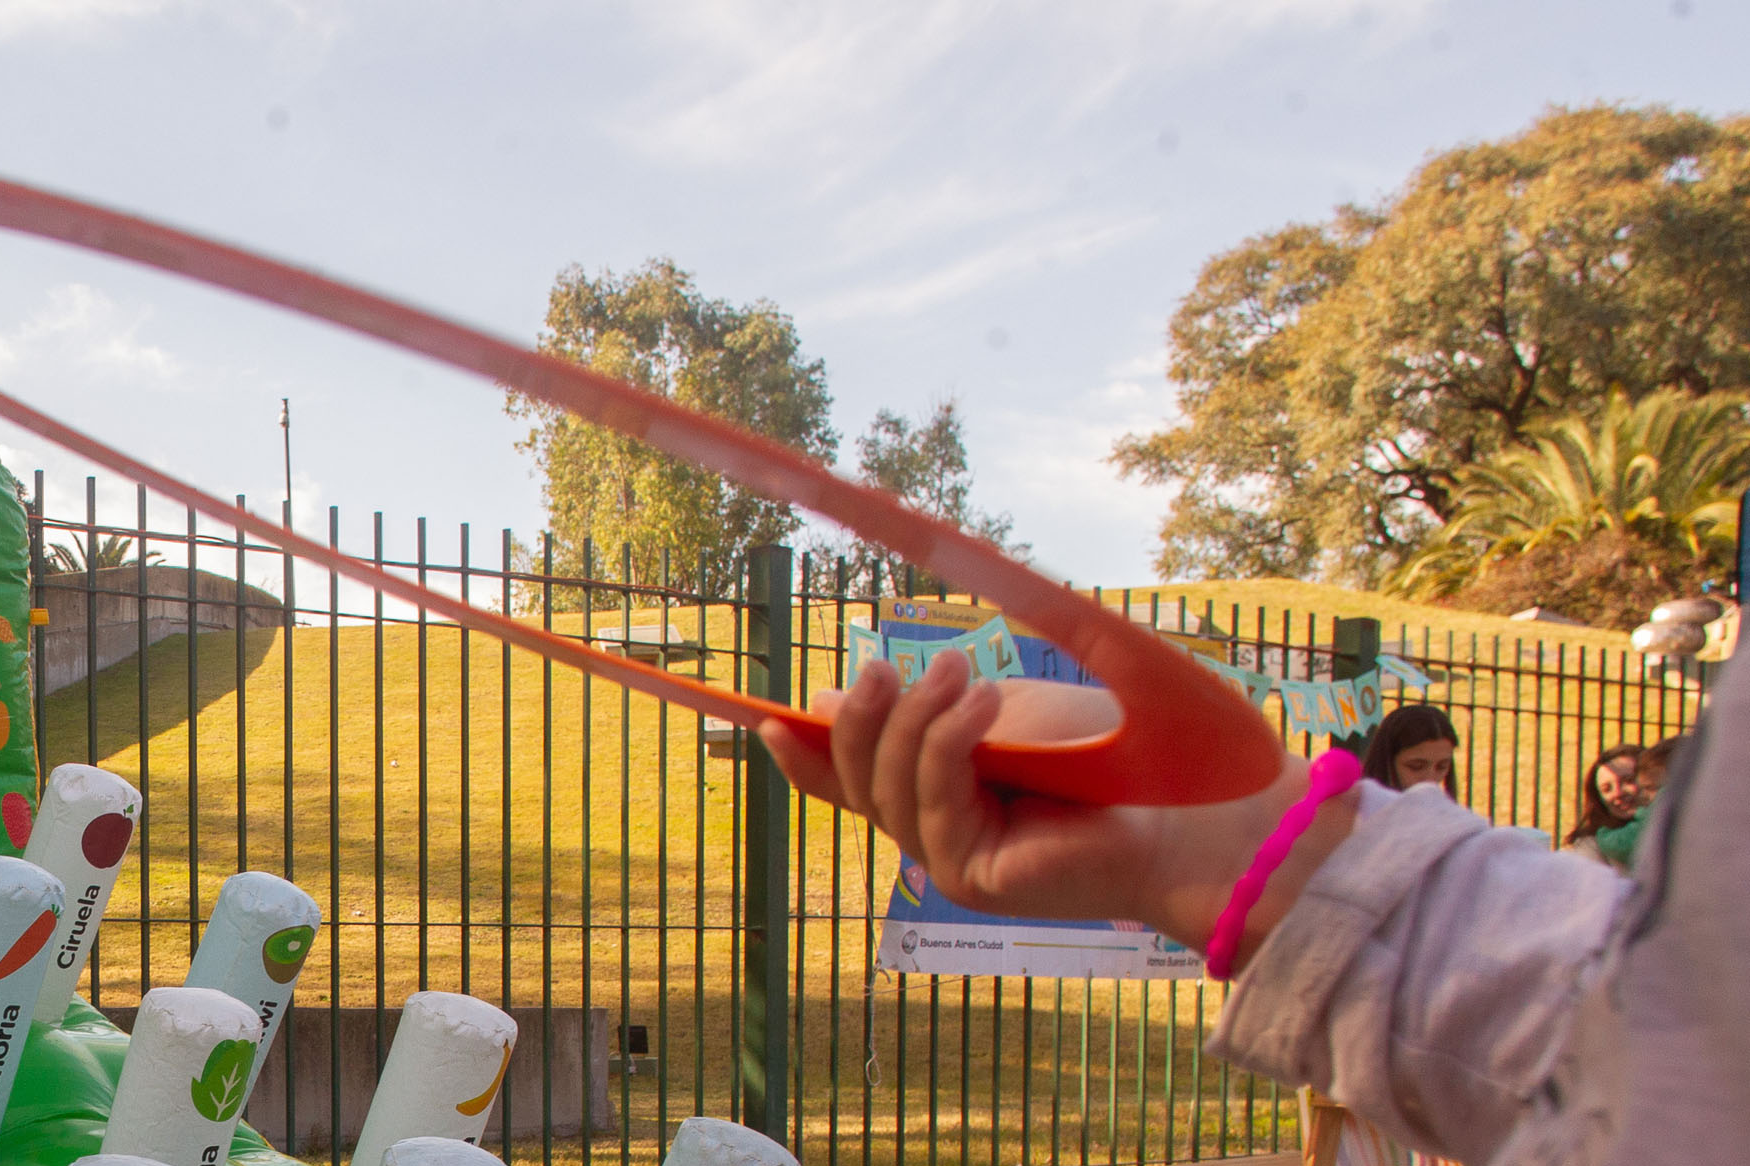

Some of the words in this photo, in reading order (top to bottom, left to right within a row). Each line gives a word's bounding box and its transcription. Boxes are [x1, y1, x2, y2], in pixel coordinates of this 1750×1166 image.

[855, 630, 1012, 688] FEIZ
[57, 884, 101, 969] Ciruela
[919, 937, 952, 949] Buenos
[954, 938, 976, 949] Aires
[977, 939, 1004, 950] Ciudad
